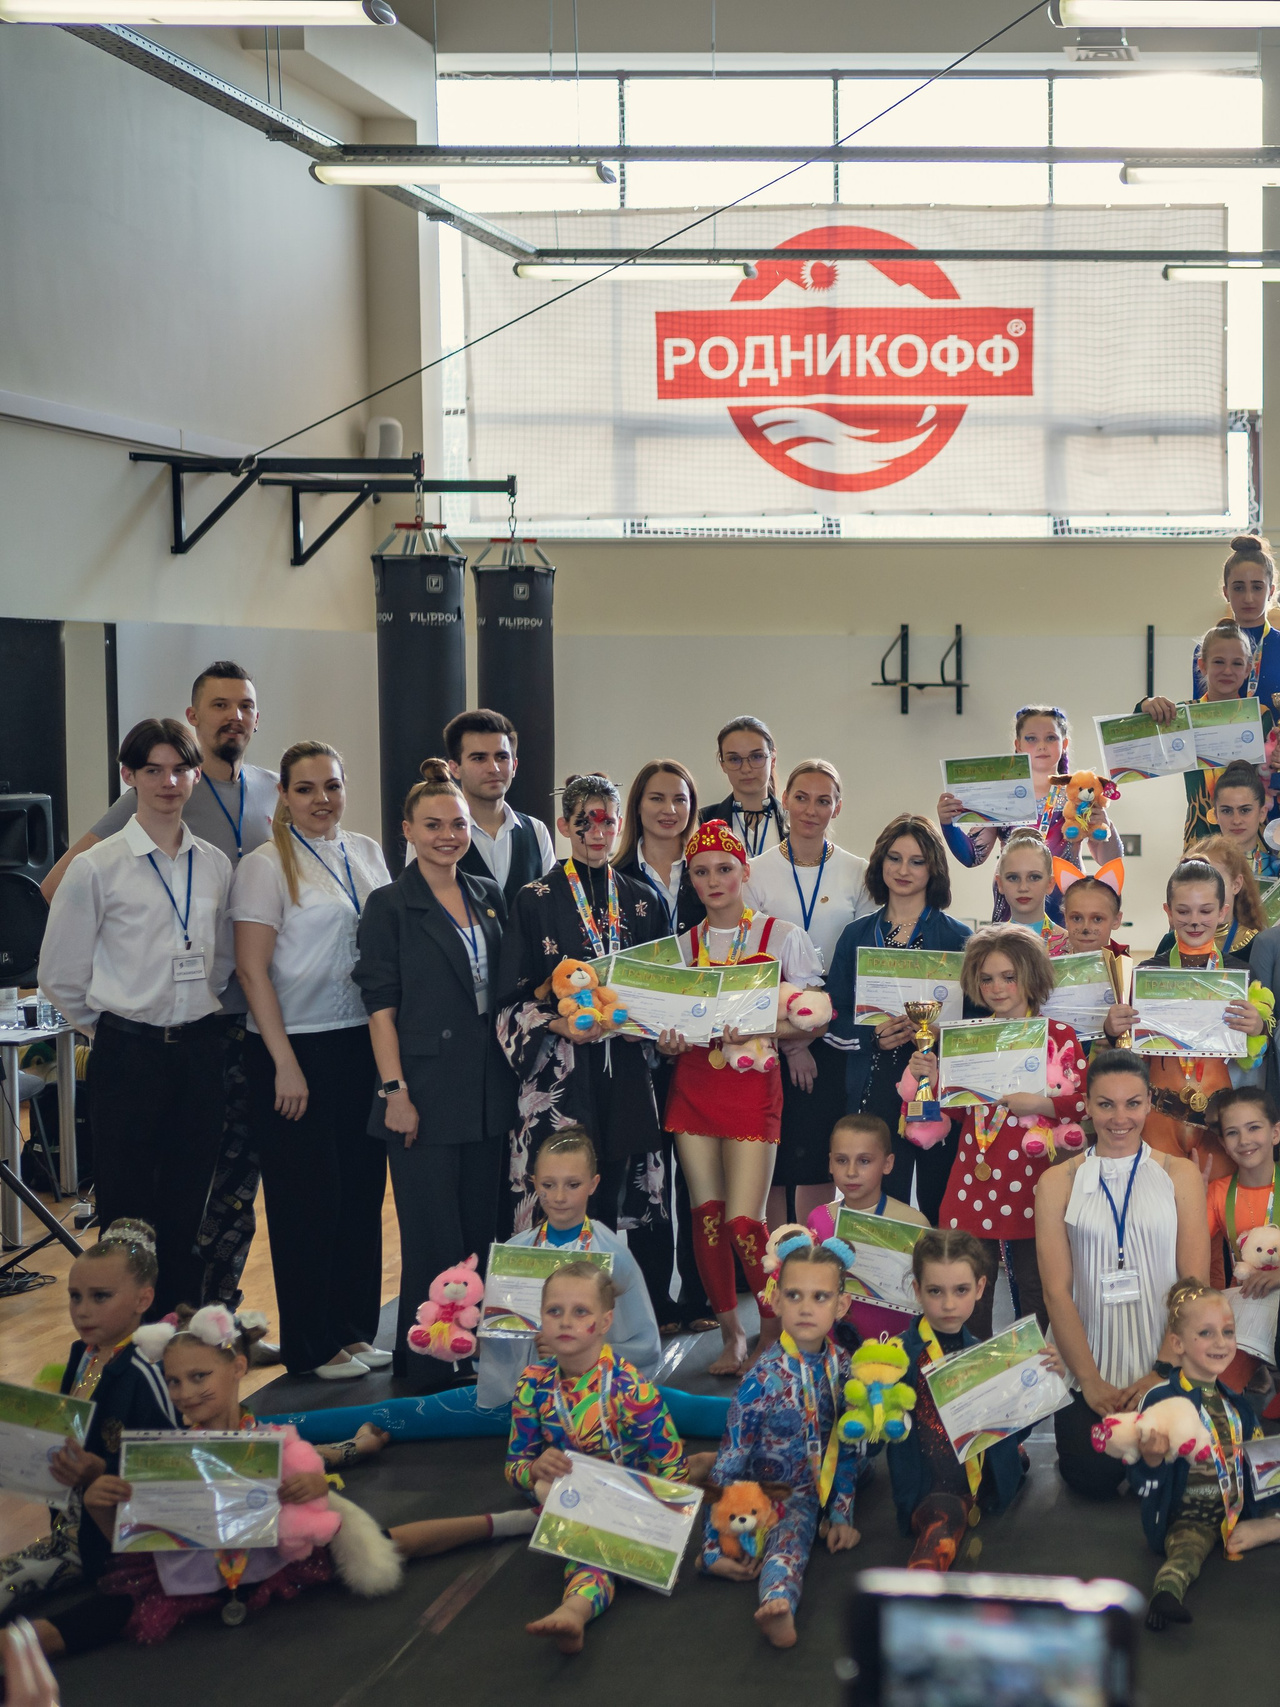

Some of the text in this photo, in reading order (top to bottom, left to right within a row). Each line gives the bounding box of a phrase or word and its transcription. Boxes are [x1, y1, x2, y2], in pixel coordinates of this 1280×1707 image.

[663, 333, 1019, 387] РОДНИКОФФ
[409, 612, 458, 623] FILIPPOV
[498, 616, 543, 628] FILIPPOV
[866, 956, 921, 970] ГРАМОТА
[621, 966, 677, 985] ГРАМОТА
[1144, 979, 1201, 991] ГРАМОТА
[951, 1033, 996, 1047] ГРАМОТ
